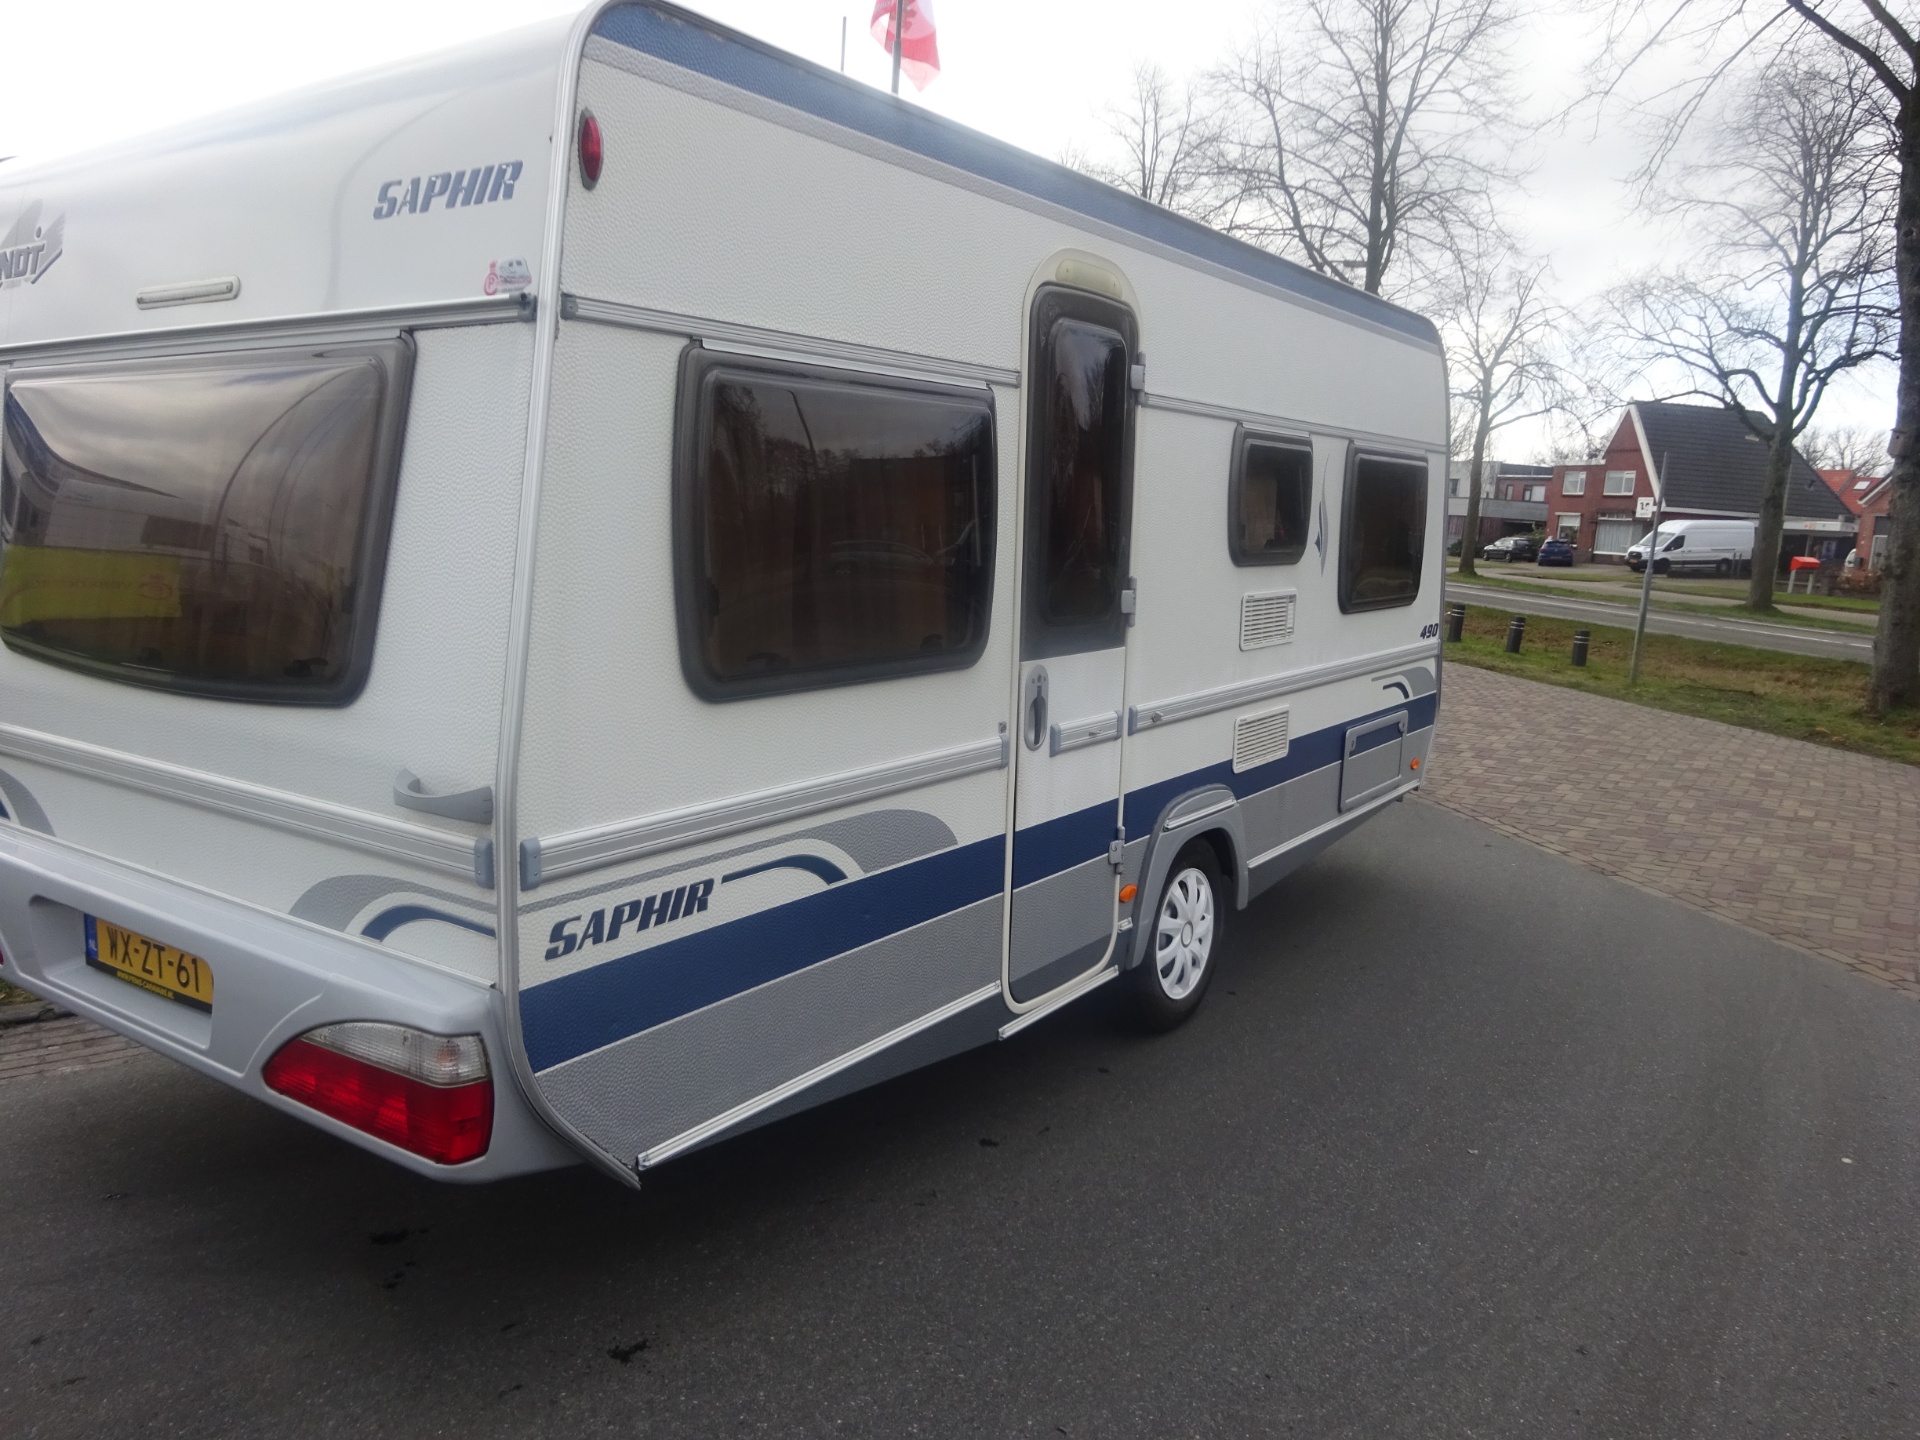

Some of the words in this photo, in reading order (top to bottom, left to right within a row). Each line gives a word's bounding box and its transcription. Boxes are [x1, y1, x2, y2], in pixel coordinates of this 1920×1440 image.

[373, 160, 523, 220] SAPHIR
[1420, 623, 1438, 639] 490
[545, 878, 714, 961] SAPHIR
[107, 926, 200, 993] WX-ZT-61
